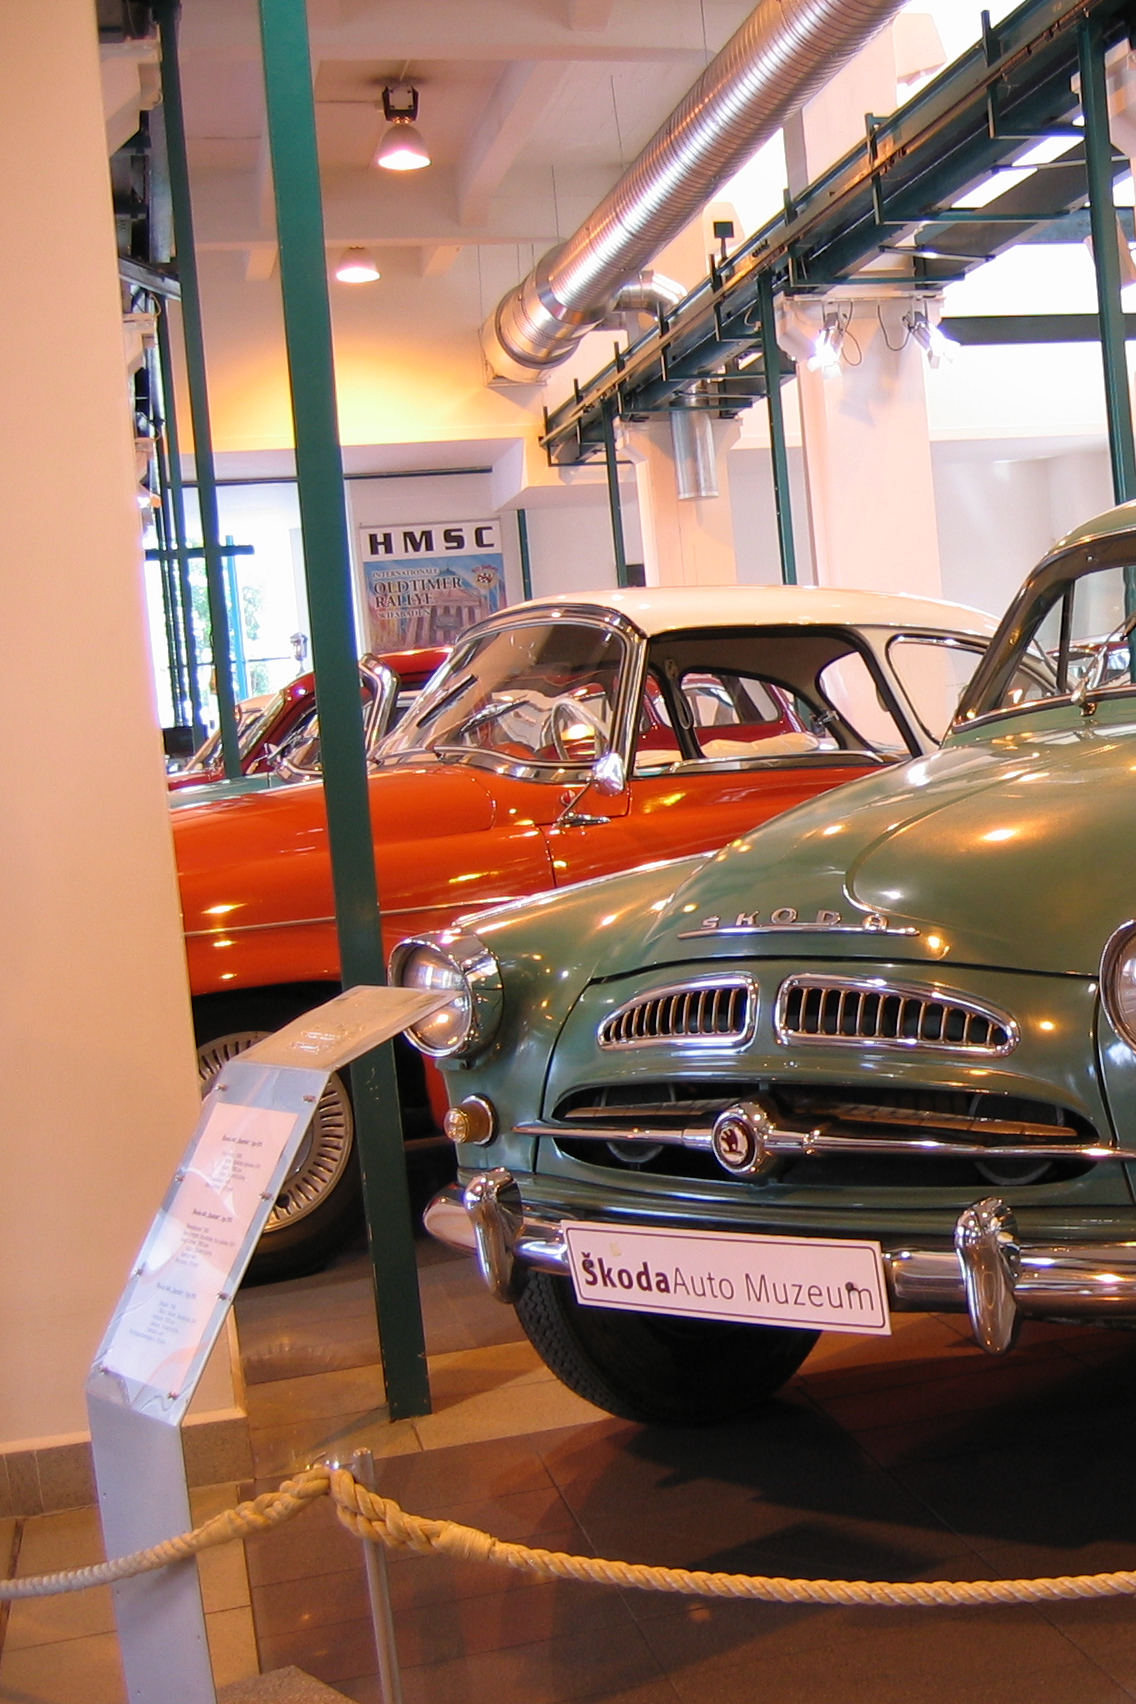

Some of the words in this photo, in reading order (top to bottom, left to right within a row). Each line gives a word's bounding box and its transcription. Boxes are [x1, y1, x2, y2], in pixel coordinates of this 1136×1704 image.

[368, 526, 495, 555] HMSC
[374, 577, 462, 594] OLDTIMER
[375, 593, 434, 608] RALLYE
[744, 1273, 875, 1311] Muzeum
